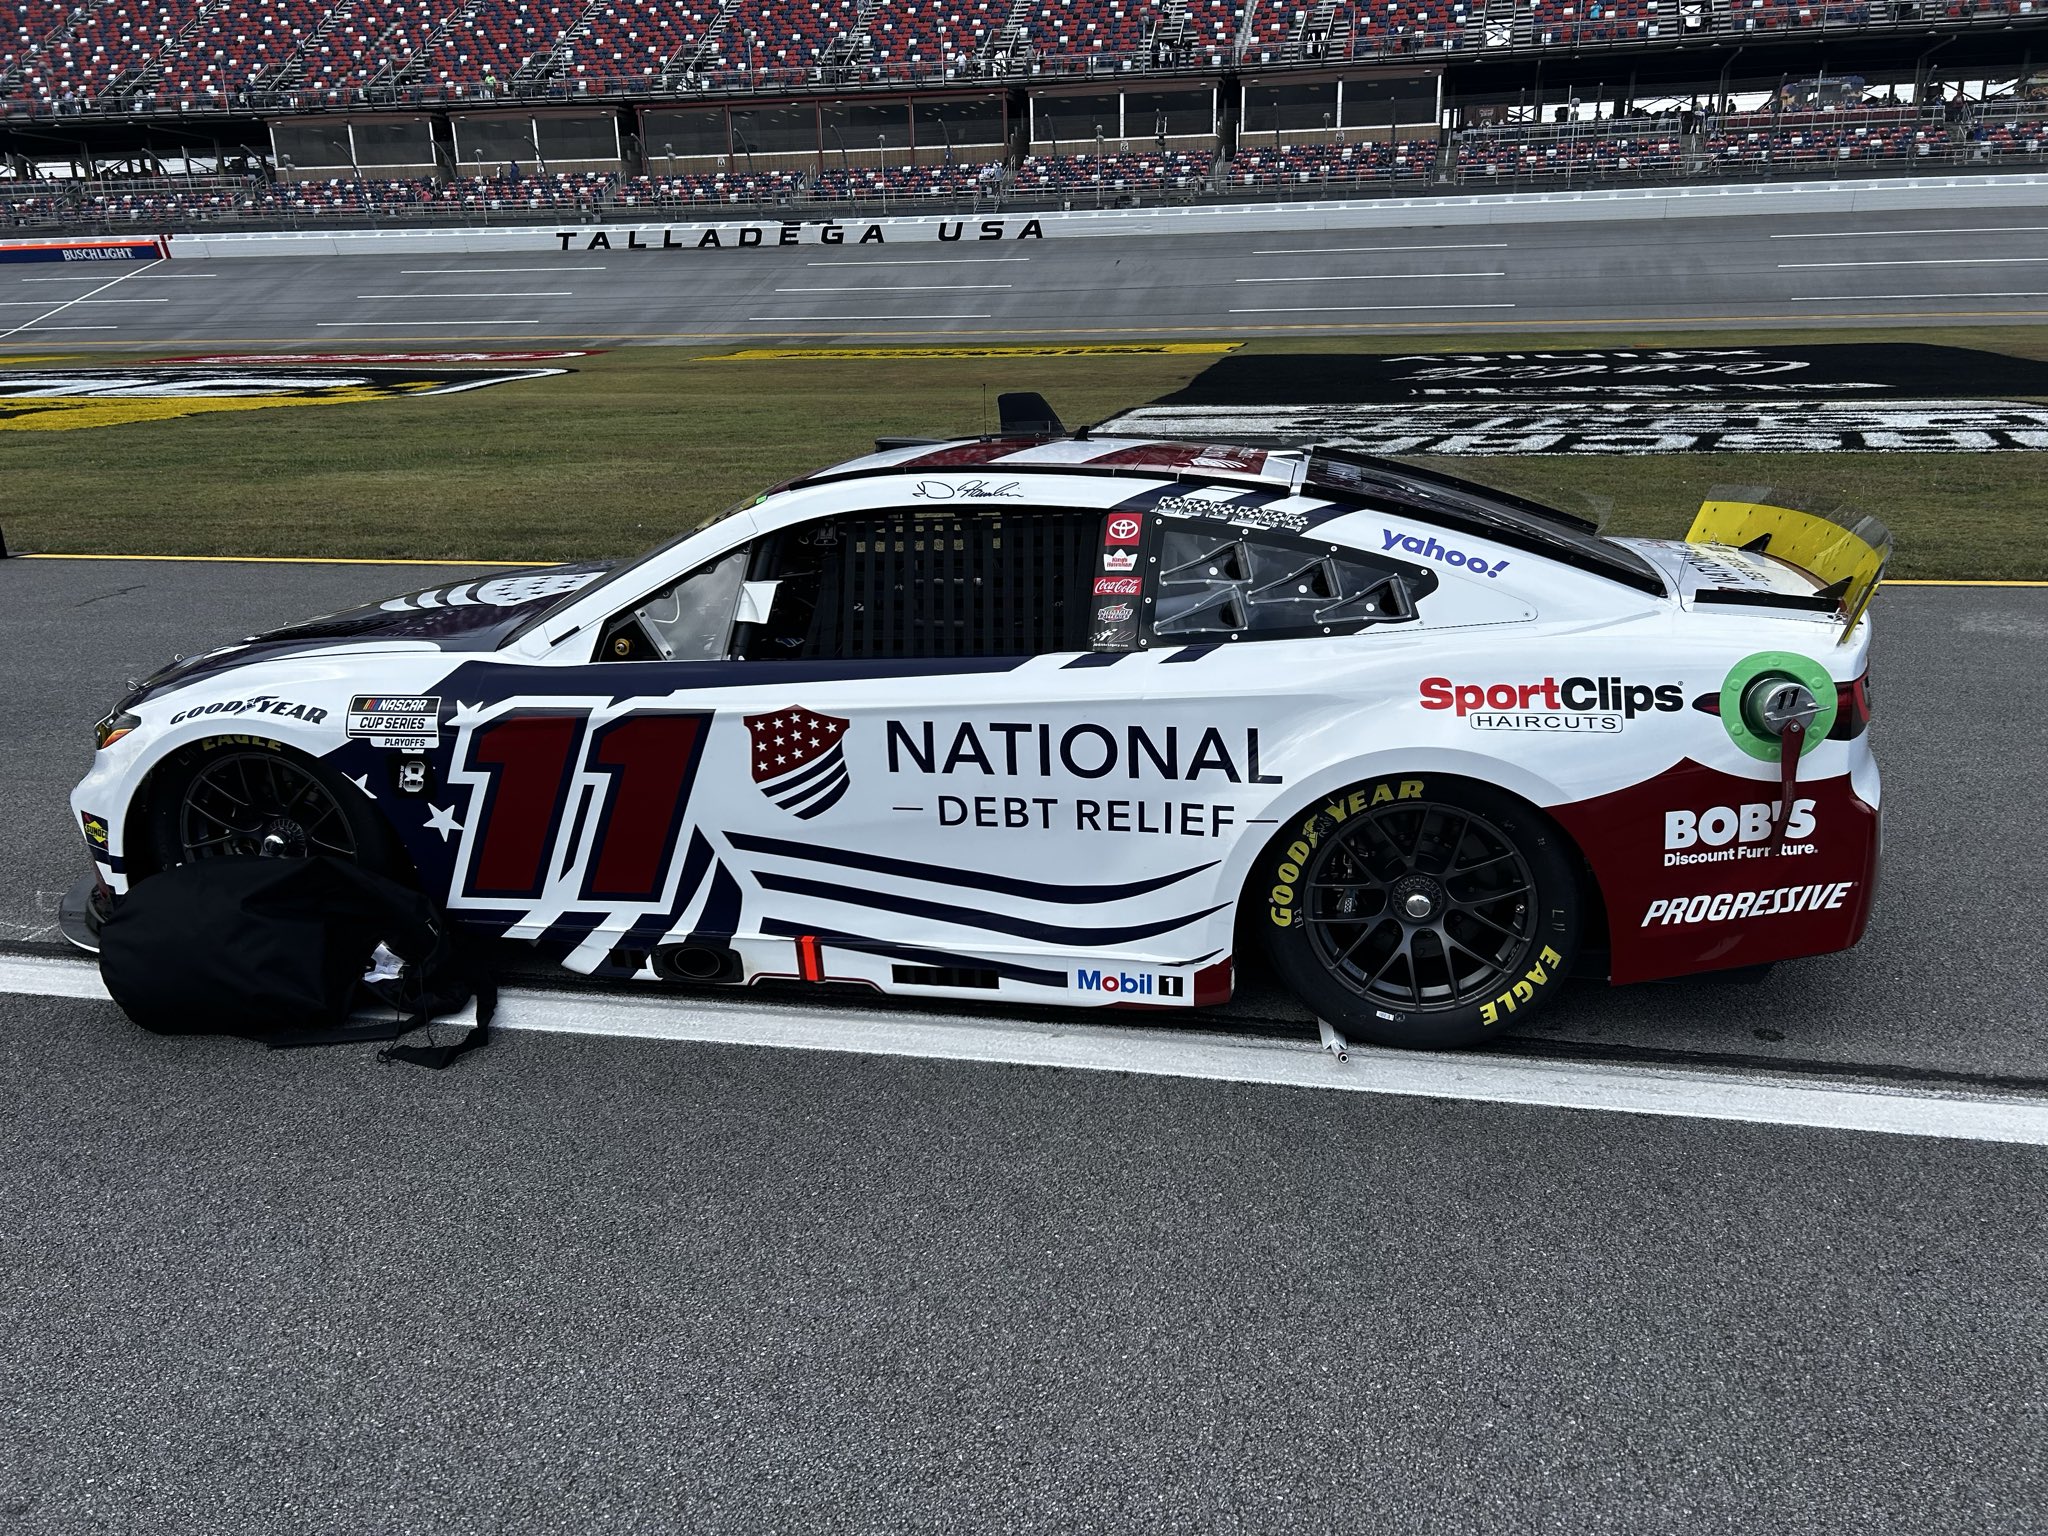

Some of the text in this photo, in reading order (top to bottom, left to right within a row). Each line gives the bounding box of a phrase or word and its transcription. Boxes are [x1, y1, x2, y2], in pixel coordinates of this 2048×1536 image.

[556, 219, 1044, 251] TALLADEGA USA
[62, 247, 134, 261] BUSCH LIGHT
[1381, 528, 1510, 578] yahoo!
[1094, 578, 1141, 593] Coca-Cola
[170, 696, 328, 725] GOODYEAR
[378, 699, 428, 711] NASCAR
[1419, 676, 1684, 720] SportClips
[1777, 687, 1800, 710] 11
[360, 716, 426, 729] CUP SERIES
[1476, 714, 1617, 731] HAIRCUTS
[201, 734, 282, 752] EAGLE
[384, 737, 426, 747] PLAYOFFS
[886, 719, 1283, 785] NATIONAL
[403, 761, 426, 792] 8
[461, 706, 717, 903] 11
[936, 795, 1235, 838] DEBT RELIEF
[1664, 798, 1817, 850] BOB'S
[1270, 780, 1425, 928] GOODYEAR
[1664, 847, 1736, 868] Discount
[1641, 881, 1854, 928] PROGRESSIVE
[1077, 968, 1153, 996] Mobil
[1478, 944, 1563, 1027] EAGLE
